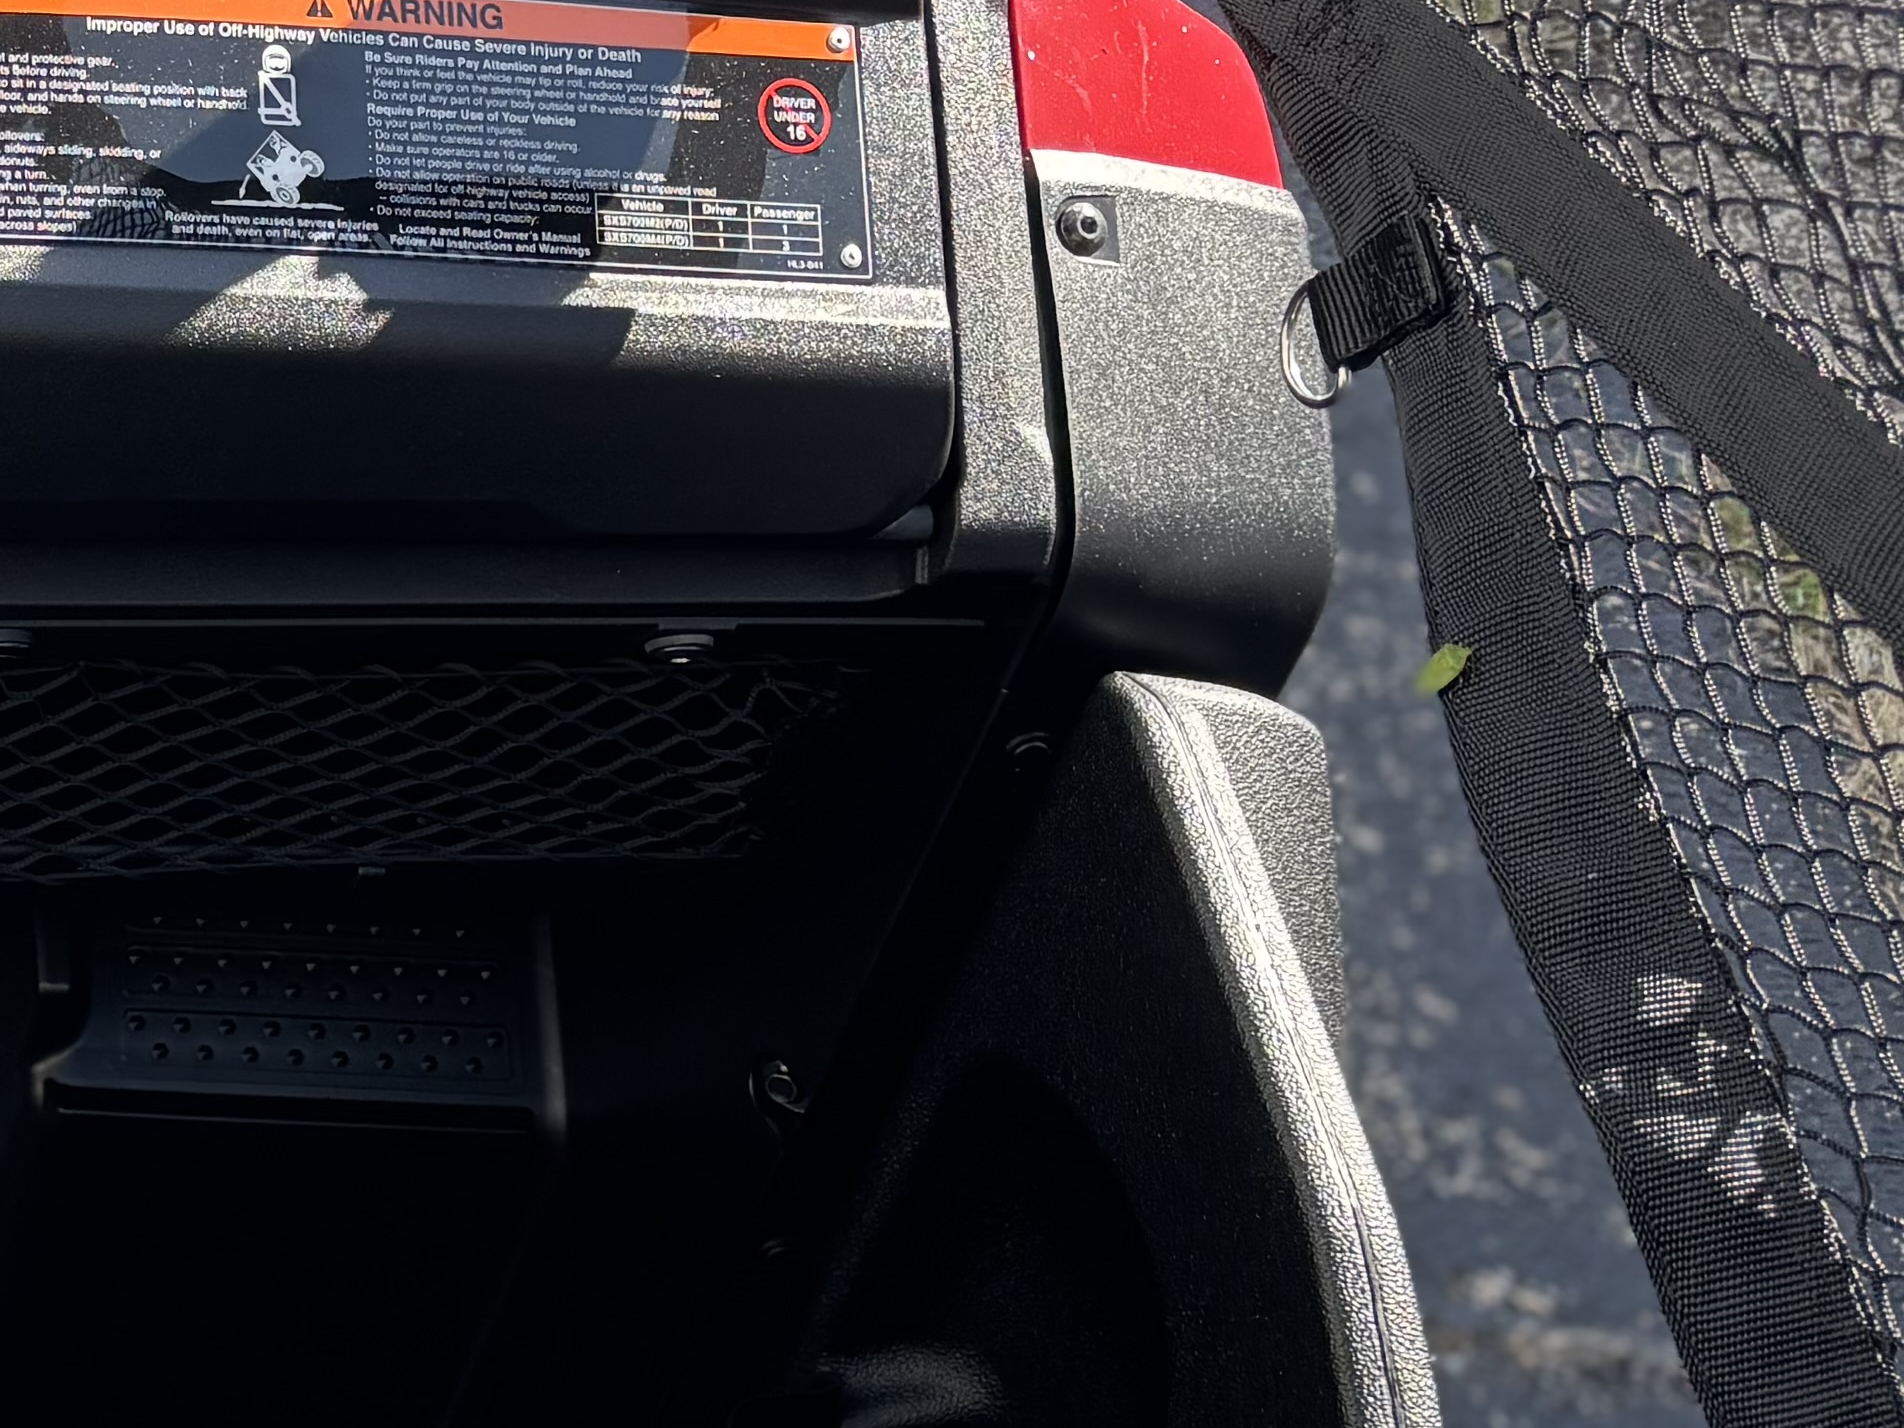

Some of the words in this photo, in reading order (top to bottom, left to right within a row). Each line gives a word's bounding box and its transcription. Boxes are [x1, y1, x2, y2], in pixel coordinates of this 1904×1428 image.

[86, 15, 159, 37] Improper
[163, 20, 194, 35] Use
[198, 22, 214, 36] of
[218, 23, 315, 46] Off-Highway
[319, 29, 383, 46] Vehicles
[388, 33, 418, 48] Can
[422, 35, 470, 52] Cause
[474, 38, 526, 55] Severe
[530, 42, 572, 61] Injury
[578, 47, 592, 59] or
[598, 46, 641, 62] Death
[364, 51, 381, 63] Be
[384, 53, 412, 65] Sure
[415, 55, 454, 67] Riders
[457, 57, 479, 71] Pay
[482, 59, 537, 72] Attention
[540, 62, 562, 74] and
[565, 64, 592, 76] Plan
[594, 66, 632, 78] Ahead
[9, 103, 51, 114] vehicle.
[773, 96, 816, 110] DRIVER
[366, 104, 413, 119] Require
[416, 106, 457, 122] Proper
[460, 109, 484, 120] Use
[486, 110, 498, 121] of
[501, 111, 529, 123] Your
[532, 113, 576, 126] Vehicle
[773, 110, 815, 123] UNDER
[786, 124, 807, 141] 16
[621, 198, 665, 213] Vehicle
[702, 203, 738, 217] Driver
[754, 206, 816, 221] Passenger
[165, 212, 219, 224] Rollovers
[222, 215, 250, 225] have
[252, 216, 294, 227] caused
[297, 220, 335, 229] severe
[337, 220, 378, 233] injuries
[398, 224, 436, 235] Locate
[439, 226, 459, 236] and
[462, 227, 490, 238] Read
[493, 229, 538, 241] Owner's
[541, 232, 580, 243] Manual
[389, 235, 426, 246] Follow
[429, 237, 444, 247] All
[446, 238, 512, 251] Instructions
[515, 242, 535, 252] and
[538, 243, 590, 258] Warnings
